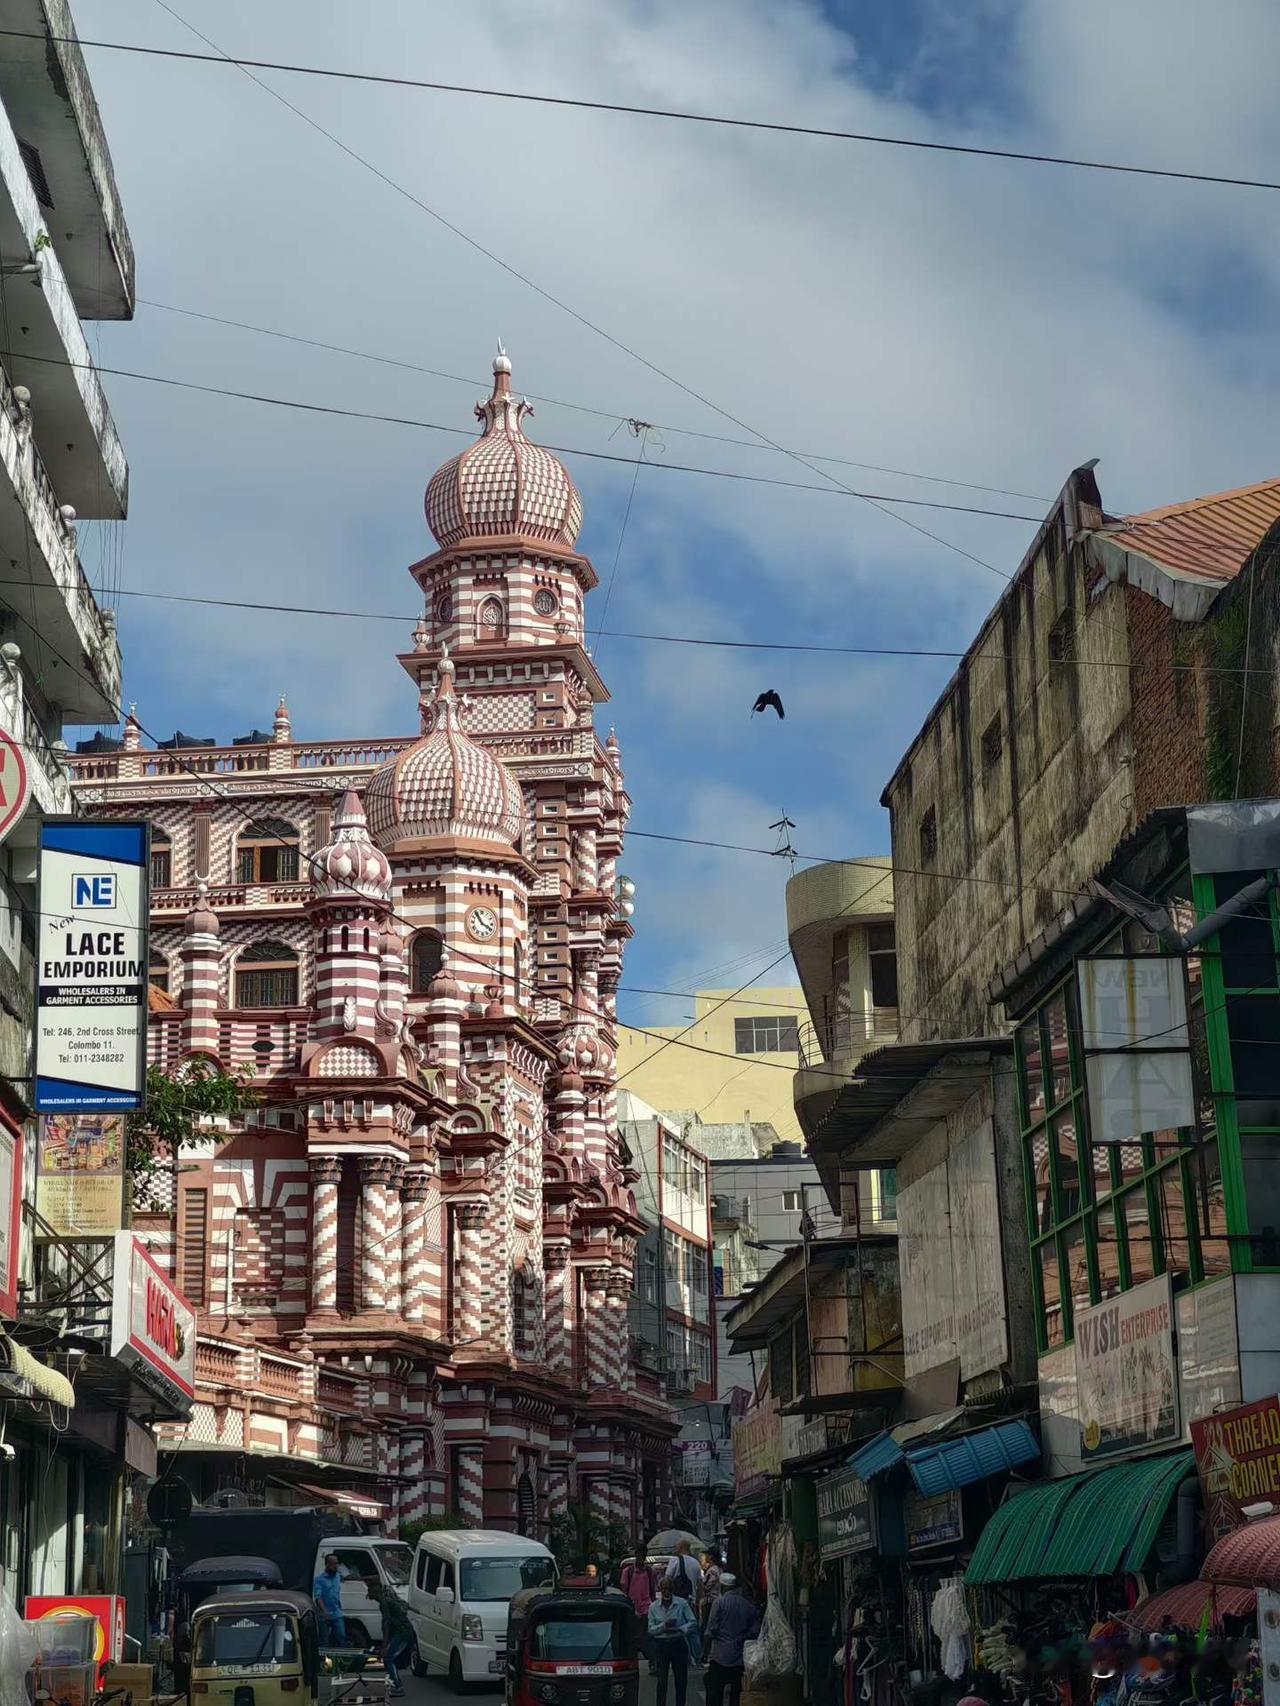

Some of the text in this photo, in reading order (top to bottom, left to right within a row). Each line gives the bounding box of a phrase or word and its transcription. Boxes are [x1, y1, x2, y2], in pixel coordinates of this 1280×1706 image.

[48, 914, 75, 934] New
[66, 932, 125, 956] LACE
[43, 961, 145, 978] EMPORIUM
[58, 986, 126, 996] WHOLESALERS IN
[46, 995, 138, 1005] GARMENT ACCESSORIES
[43, 1028, 56, 1037] Tel:
[58, 1027, 75, 1037] 246,
[77, 1027, 90, 1036] 2nd
[92, 1027, 114, 1036] Cross
[68, 1040, 101, 1050] Colombo
[58, 1054, 72, 1063] Tel:
[1077, 1306, 1120, 1360] WISH
[1121, 1303, 1169, 1346] ENTERPRISE
[1223, 1408, 1280, 1457] THREAD
[1231, 1453, 1280, 1500] CORNE
